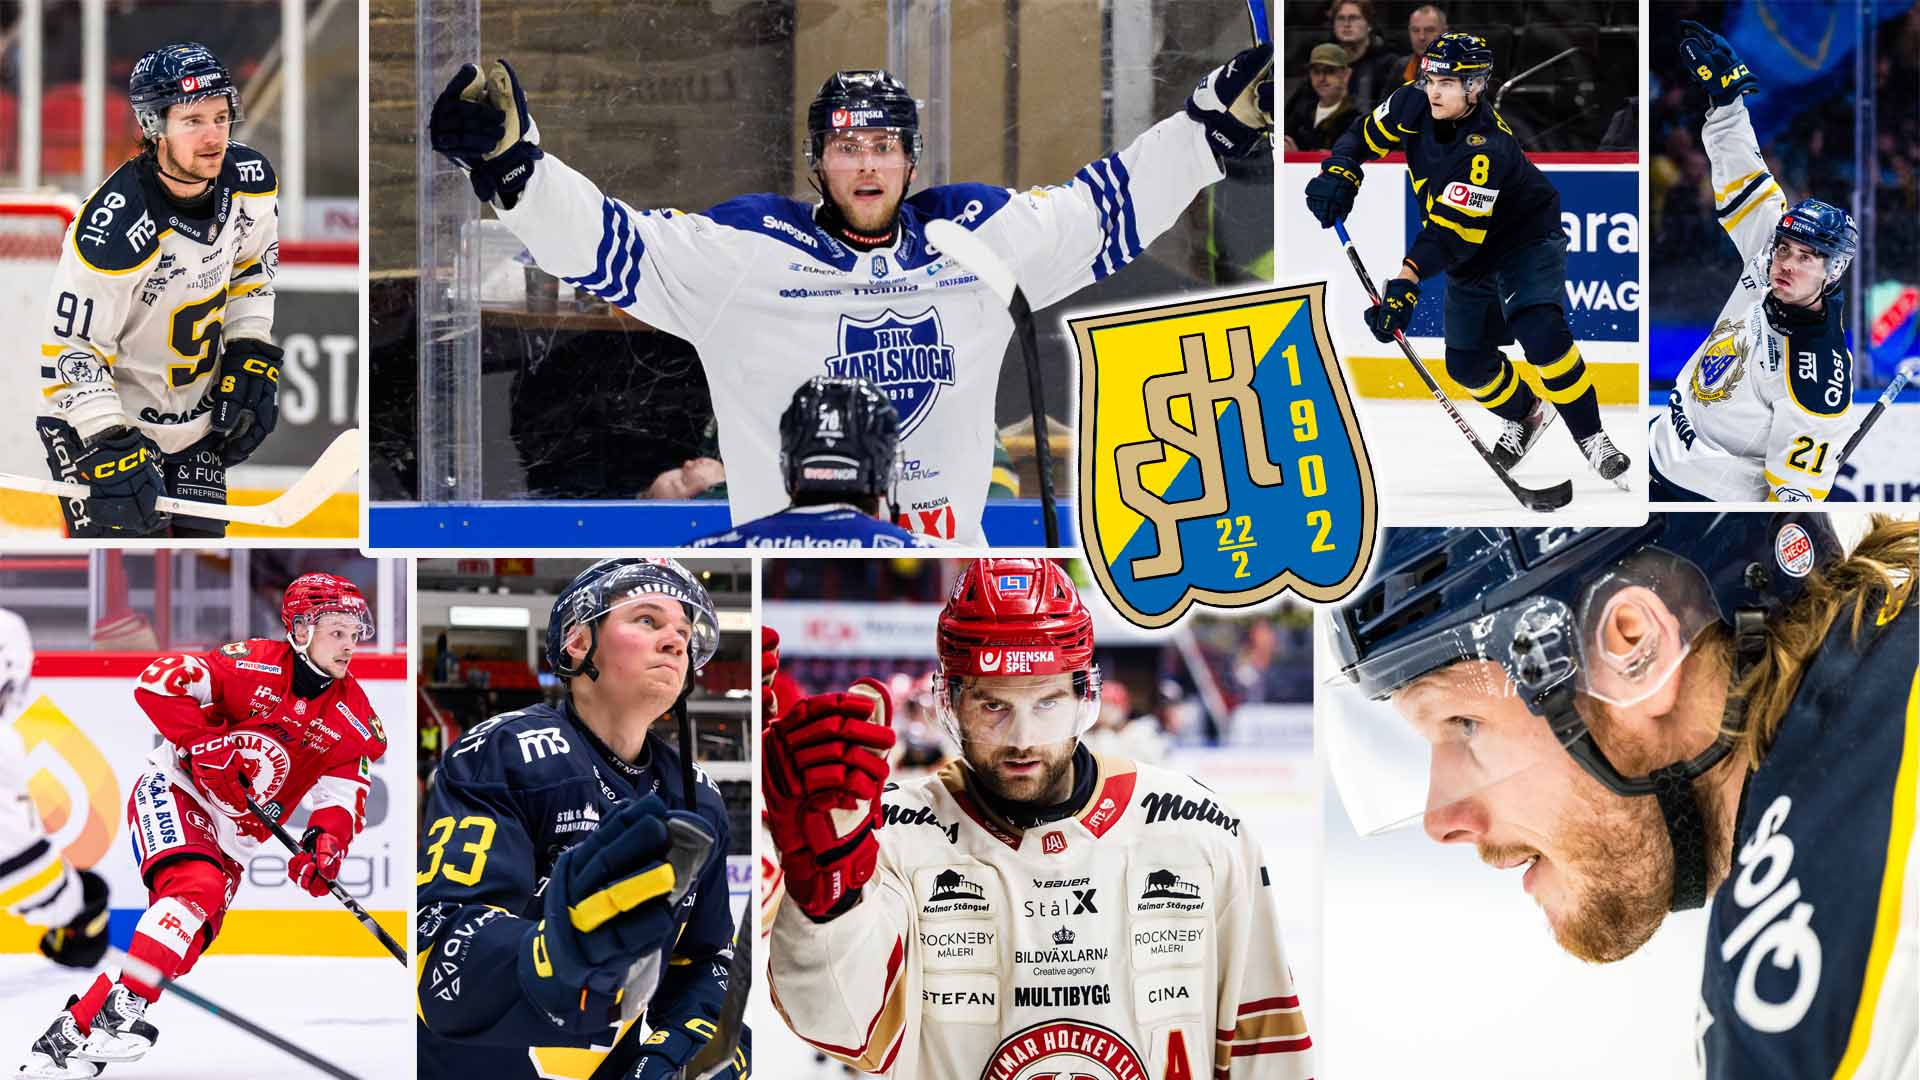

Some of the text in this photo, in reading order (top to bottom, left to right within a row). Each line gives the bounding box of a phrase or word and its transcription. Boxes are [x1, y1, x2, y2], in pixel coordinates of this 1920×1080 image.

[196, 73, 221, 84] SVENSKA
[1720, 63, 1750, 89] CM
[850, 109, 883, 120] SVENSKA
[850, 118, 868, 127] SPEL
[1470, 153, 1490, 187] 8
[1469, 199, 1484, 208] SPEL
[80, 191, 127, 247] ecit
[178, 222, 192, 233] GEO
[1793, 221, 1815, 233] SVENSKA
[762, 215, 818, 249] Swegon
[202, 248, 223, 264] CCM
[1741, 274, 1757, 291] LT
[141, 291, 158, 307] LT
[53, 290, 95, 343] 91
[876, 330, 912, 349] BIK
[243, 357, 280, 385] CC
[829, 346, 953, 385] KARLSKOGA
[220, 374, 237, 393] S
[280, 333, 359, 426] ST
[1668, 387, 1697, 452] CANIA
[1787, 434, 1831, 475] 21
[177, 465, 190, 480] &
[896, 505, 956, 541] AXI
[1782, 537, 1810, 560] HECO
[1005, 651, 1055, 663] SVENSKA
[243, 662, 280, 673] INTERSPORT
[1005, 662, 1032, 673] SPEL
[234, 735, 287, 799] OJA-LJUNGBY
[1140, 792, 1240, 837] Molins
[156, 811, 177, 844] BUSS
[416, 815, 497, 887] 33
[1043, 877, 1090, 889] BAUER
[922, 902, 990, 914] Kalmar Stängsel
[1137, 900, 1205, 912] Kalmar Stängsel
[919, 931, 995, 947] ROCKNEBY
[1134, 927, 1205, 946] ROCKNEBY
[937, 947, 974, 959] MÅLERI
[1014, 946, 1109, 964] BILDVÄXLARNA
[1150, 943, 1185, 955] MÅLERI
[1032, 965, 1097, 977] Creative agency
[921, 989, 996, 1006] STEFAN
[1014, 983, 1111, 1008] MULTIBYGG
[1148, 985, 1190, 1004] CINA
[985, 1029, 1146, 1080] ALMAR HOCKEY CLU
[1164, 1029, 1193, 1080] A
[634, 1056, 649, 1079] CCM
